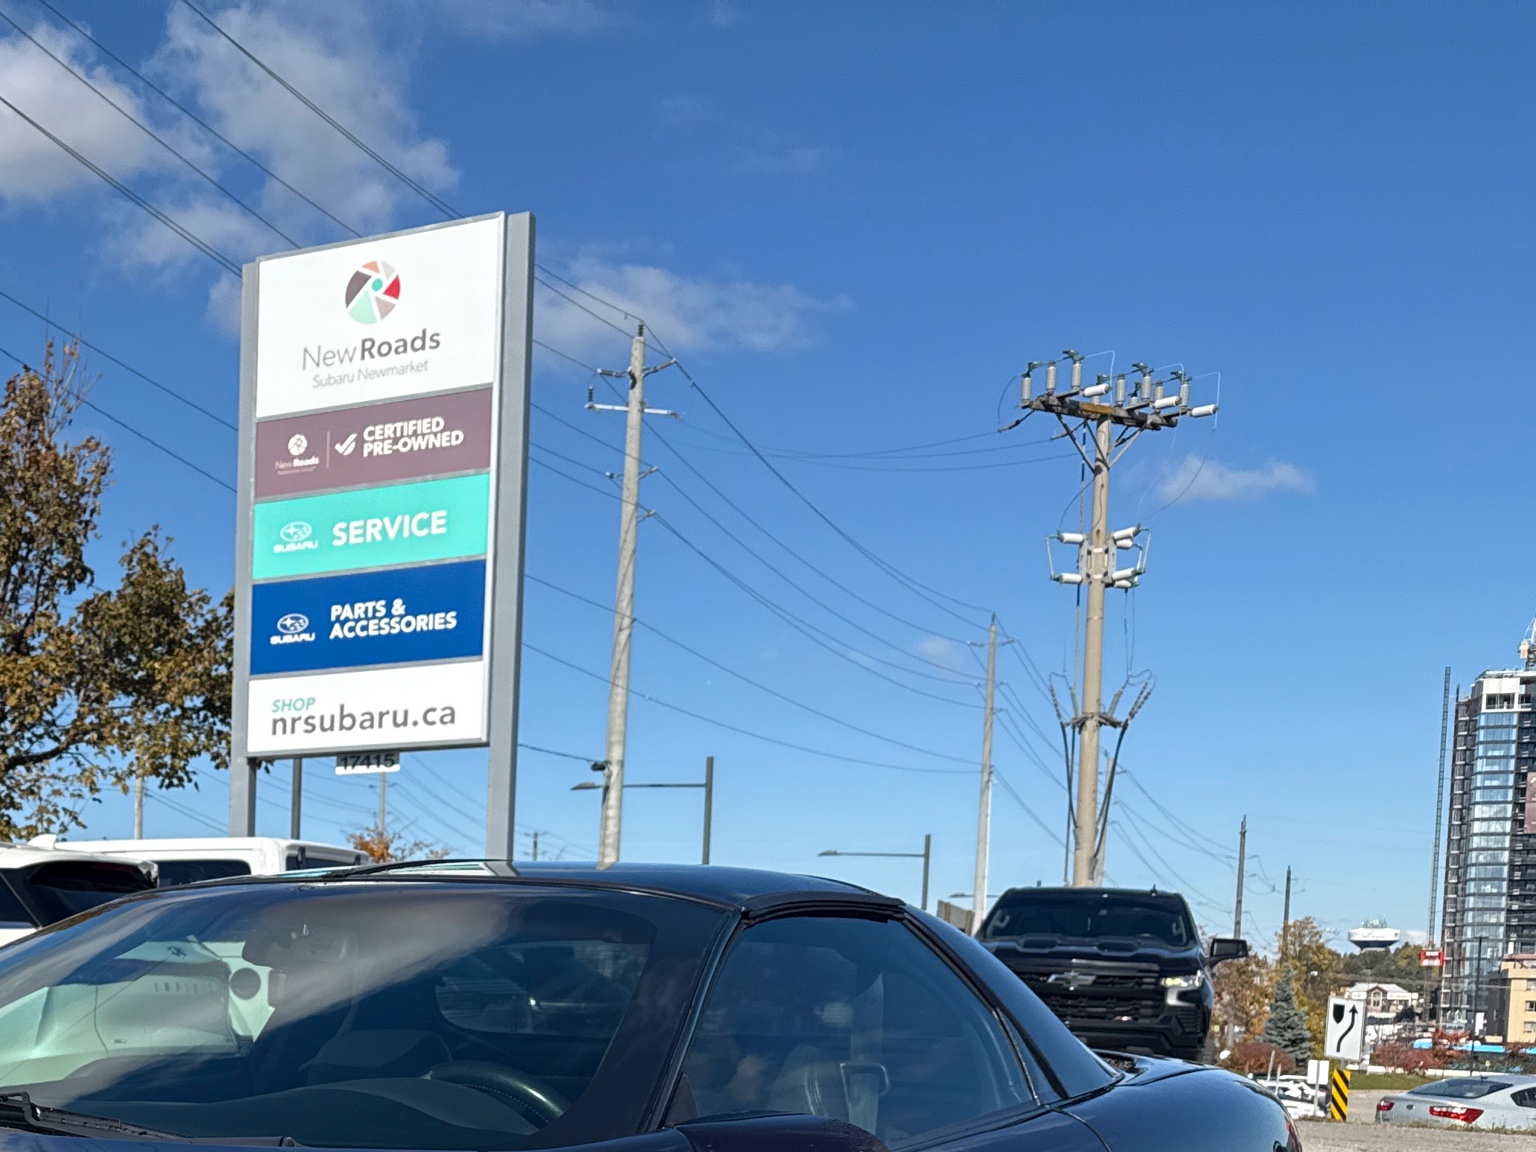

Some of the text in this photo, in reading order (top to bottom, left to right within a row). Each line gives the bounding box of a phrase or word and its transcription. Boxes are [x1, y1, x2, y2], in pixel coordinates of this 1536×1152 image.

[312, 360, 429, 389] Subaru Newmarket
[363, 416, 445, 442] CERTIFIED
[363, 430, 464, 458] PRE-OWNED
[332, 510, 448, 547] SERVICE
[273, 540, 319, 554] SUBARU
[331, 598, 406, 622] PARTS &
[270, 632, 316, 645] SUBARU
[329, 611, 457, 640] ACCESSORIES
[271, 697, 316, 713] SHOP
[271, 703, 456, 736] nrsubaru.ca
[340, 753, 396, 771] 17415
